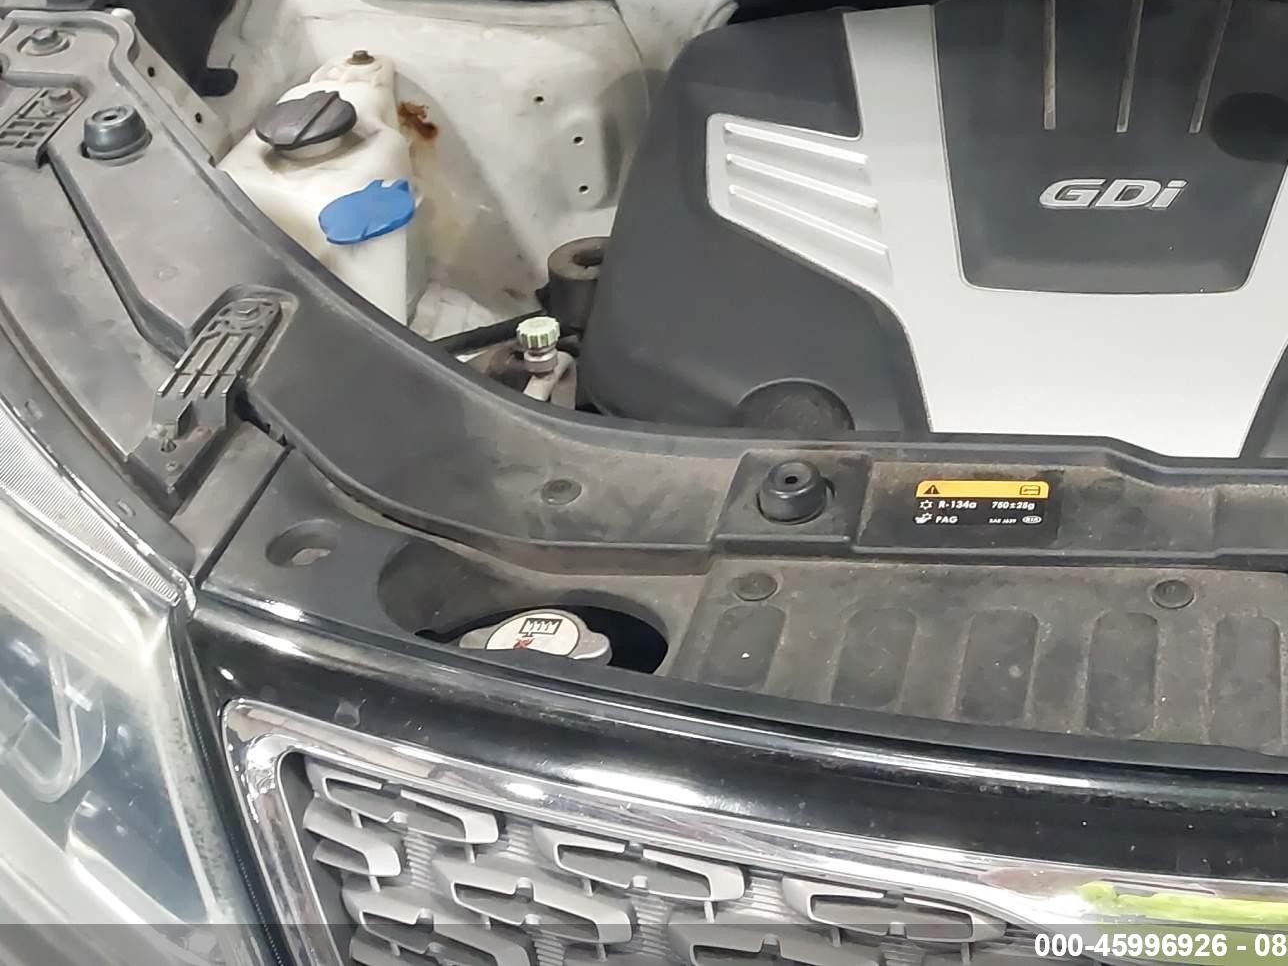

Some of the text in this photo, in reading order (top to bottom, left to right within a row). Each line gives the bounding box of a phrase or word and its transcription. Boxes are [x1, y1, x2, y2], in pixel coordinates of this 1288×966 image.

[1039, 178, 1187, 209] GDi
[938, 500, 977, 509] R-134a
[935, 515, 958, 524] PAG
